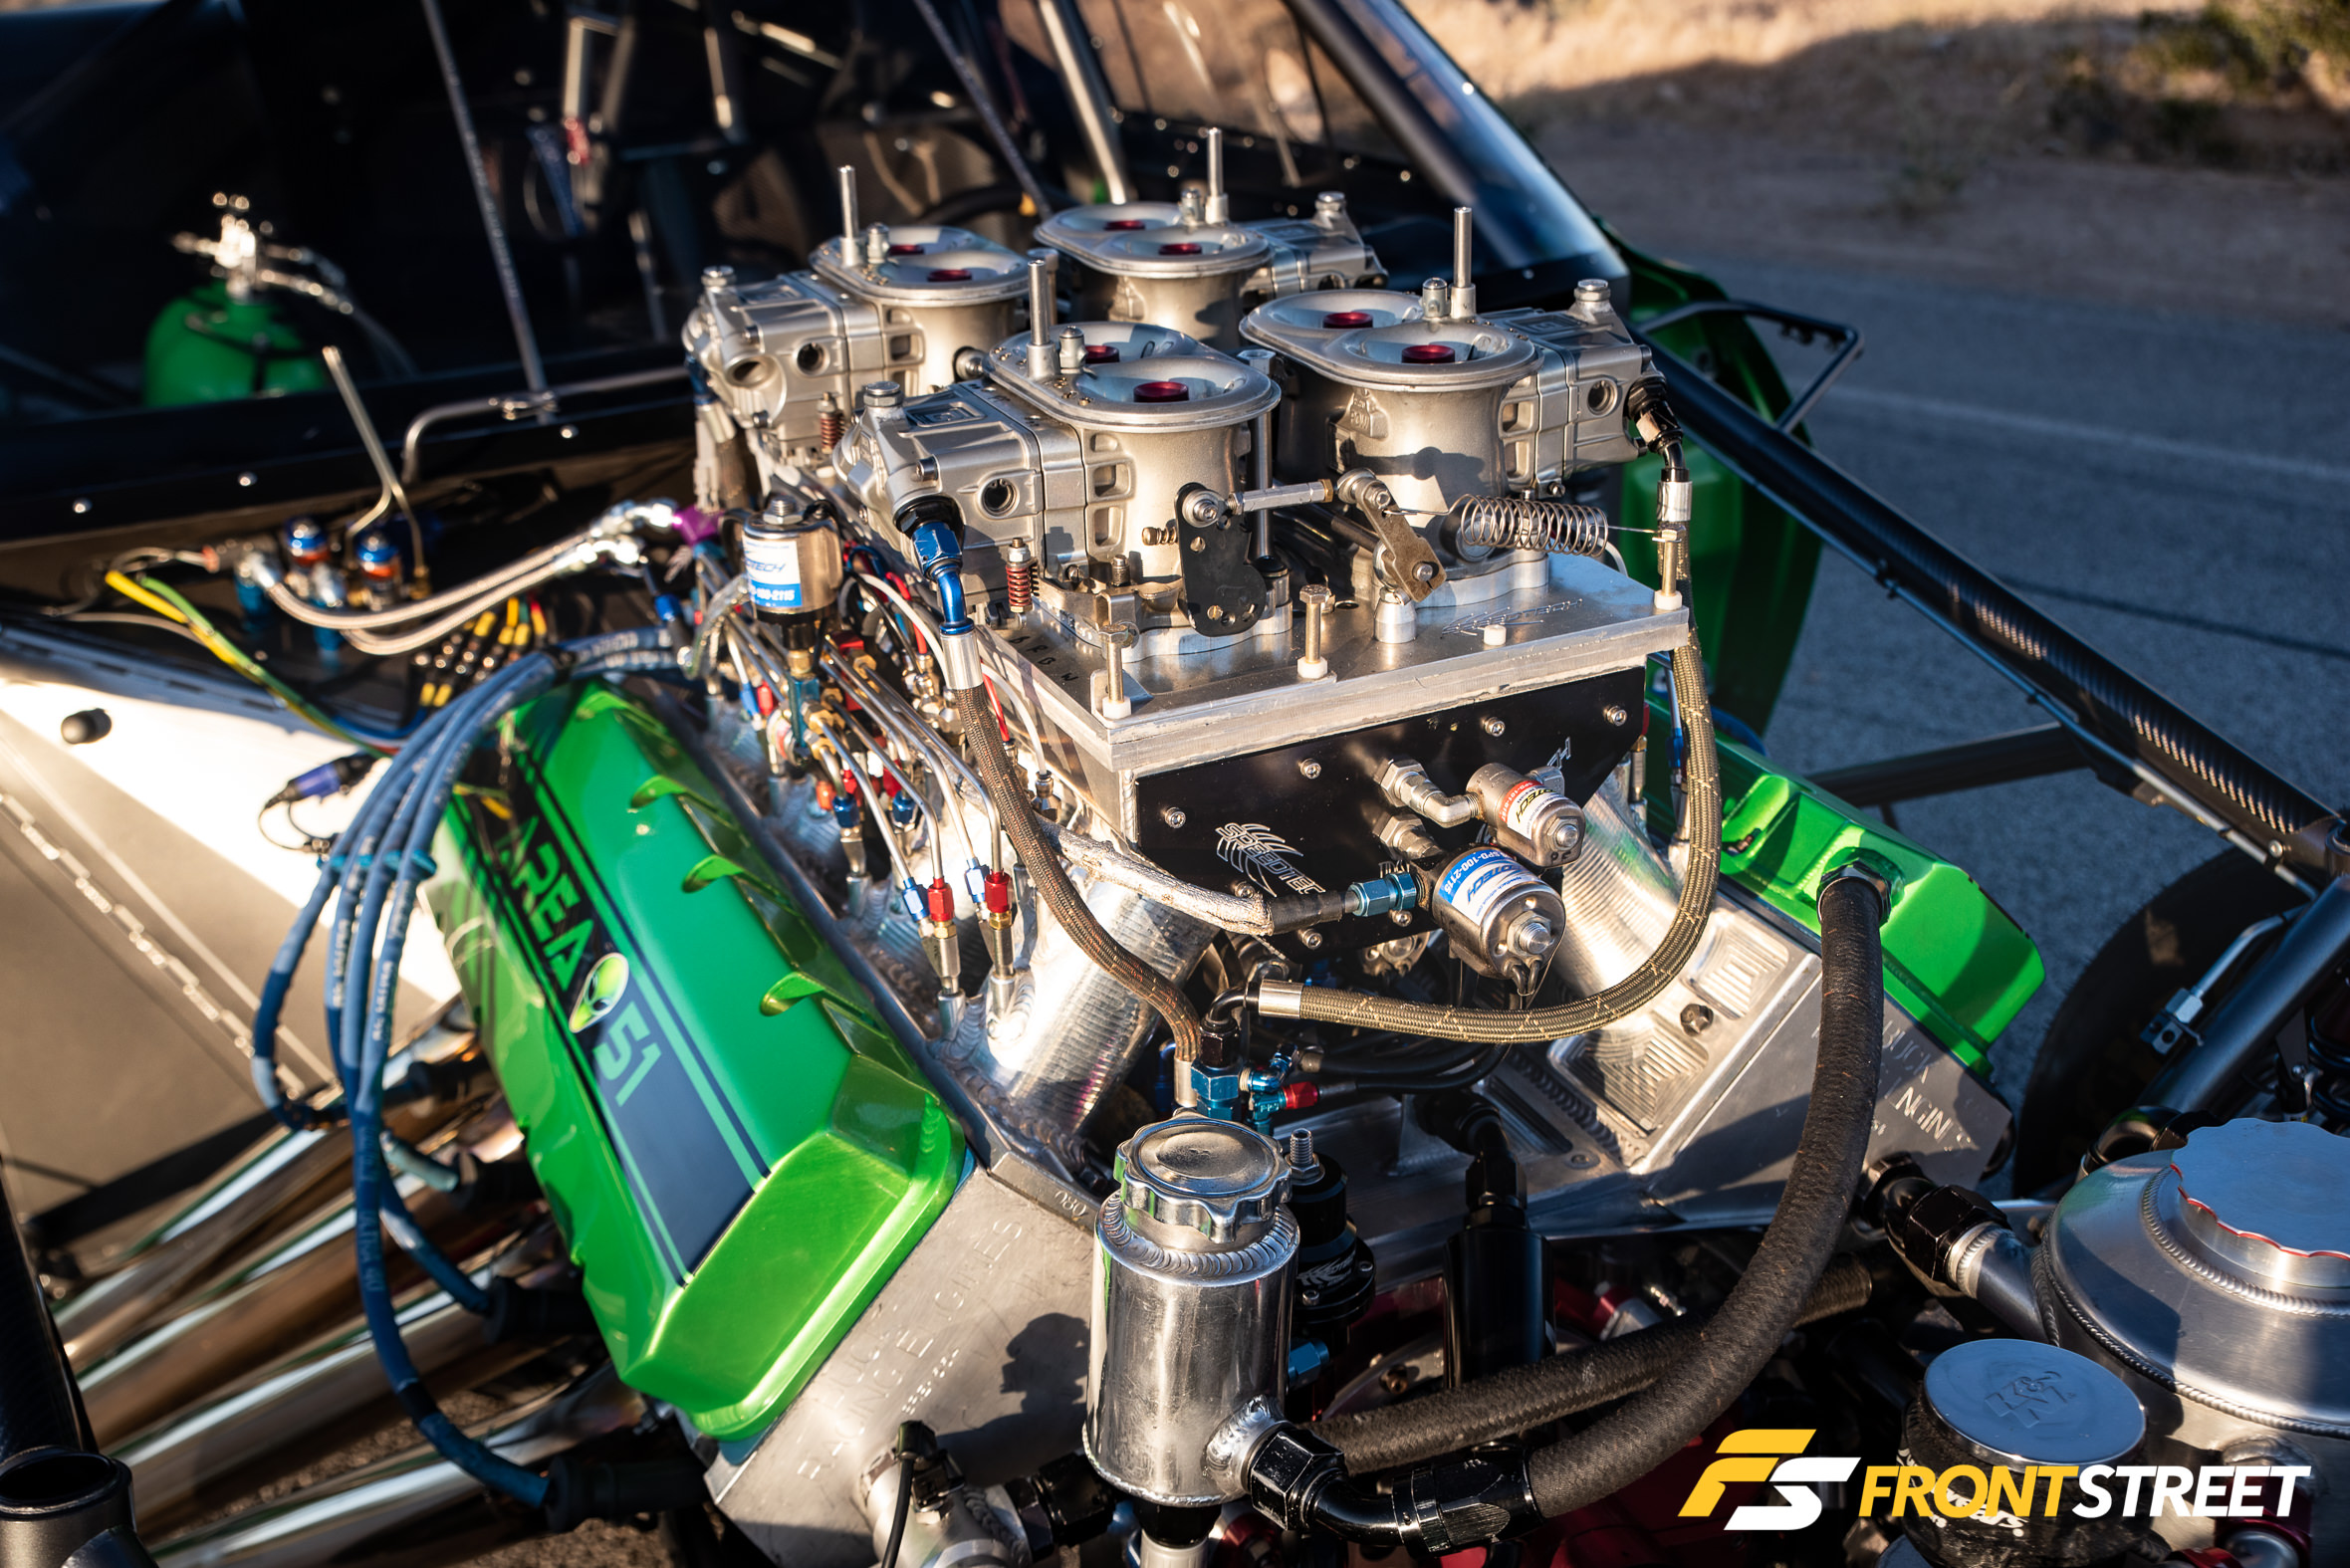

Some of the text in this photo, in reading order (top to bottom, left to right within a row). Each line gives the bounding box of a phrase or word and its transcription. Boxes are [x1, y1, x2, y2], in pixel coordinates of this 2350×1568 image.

[1215, 822, 1326, 895] SPEEDTEC
[494, 818, 661, 1107] AREA 51
